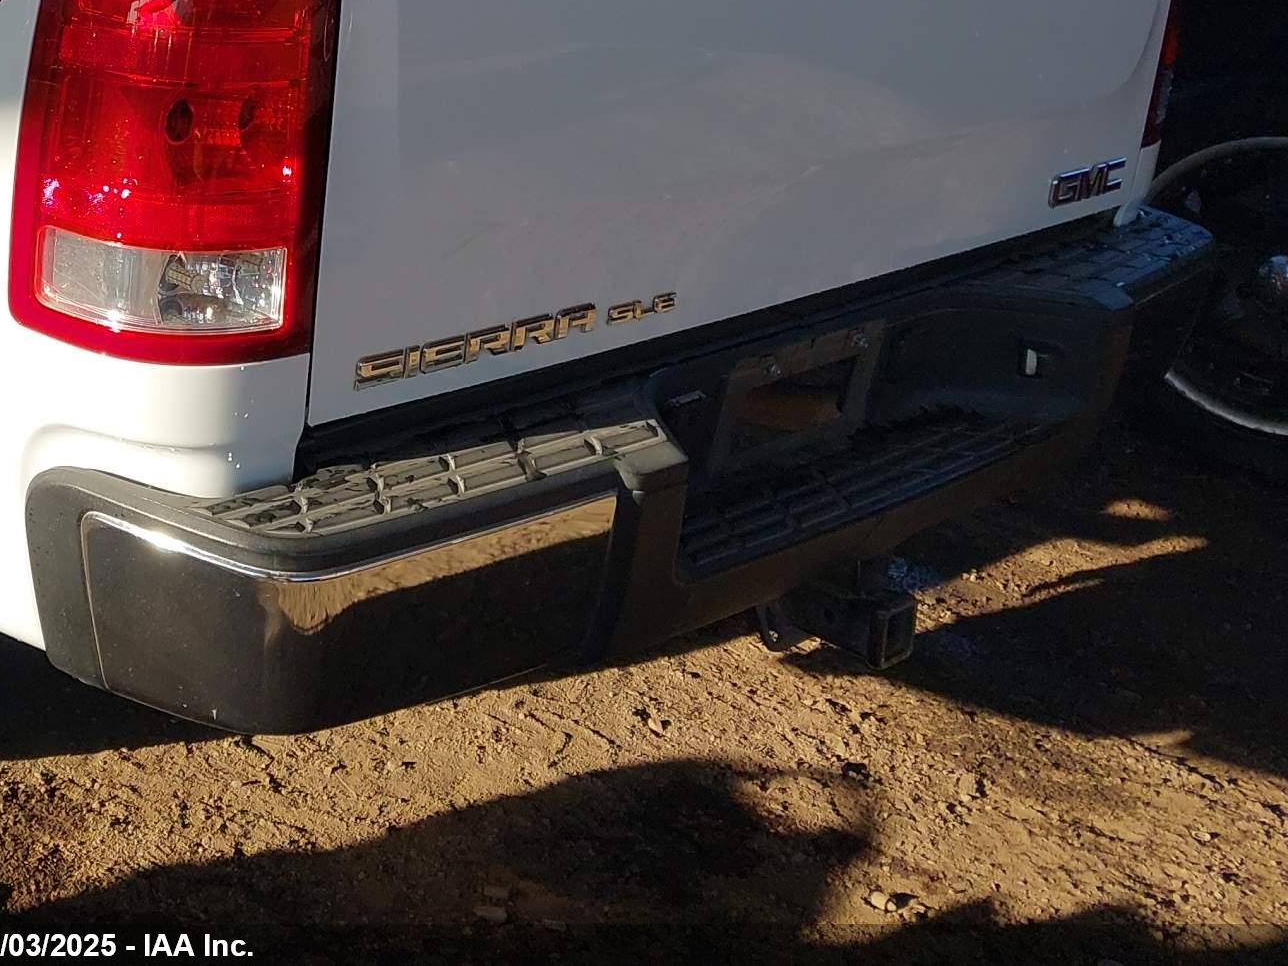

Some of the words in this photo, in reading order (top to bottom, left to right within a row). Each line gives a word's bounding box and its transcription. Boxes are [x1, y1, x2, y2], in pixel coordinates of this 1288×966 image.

[1048, 156, 1128, 209] GMC
[353, 301, 597, 391] SIERRA
[606, 291, 677, 326] SLE
